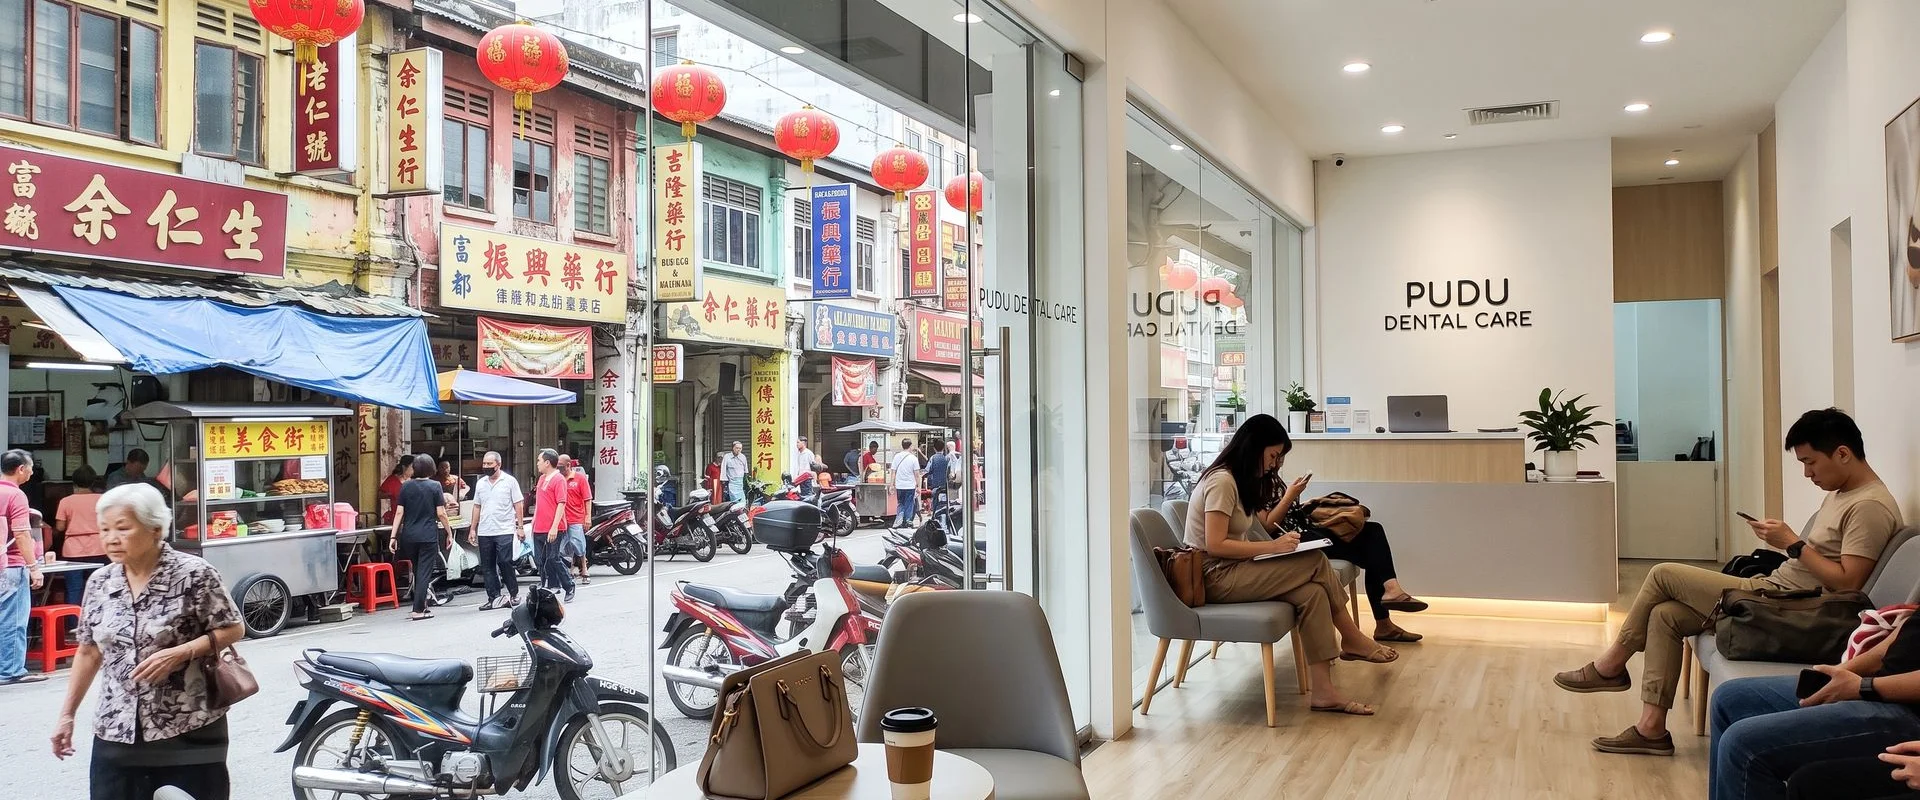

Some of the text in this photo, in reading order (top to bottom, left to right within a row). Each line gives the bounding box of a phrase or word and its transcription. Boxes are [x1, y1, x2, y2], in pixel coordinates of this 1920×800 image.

[305, 59, 332, 163] 老仁號
[396, 58, 420, 185] 余仁生行
[64, 174, 264, 262] 余仁生
[665, 149, 687, 251] 吉隆藥行
[452, 234, 472, 299] 富都
[483, 240, 619, 296] 振興藥行
[1407, 278, 1509, 308] PUDU
[980, 288, 1010, 312] PUDU
[1014, 294, 1052, 319] DENTAL
[1054, 303, 1077, 323] CARE
[1385, 311, 1532, 331] DENTAL CARE
[233, 425, 304, 454] 美食街
